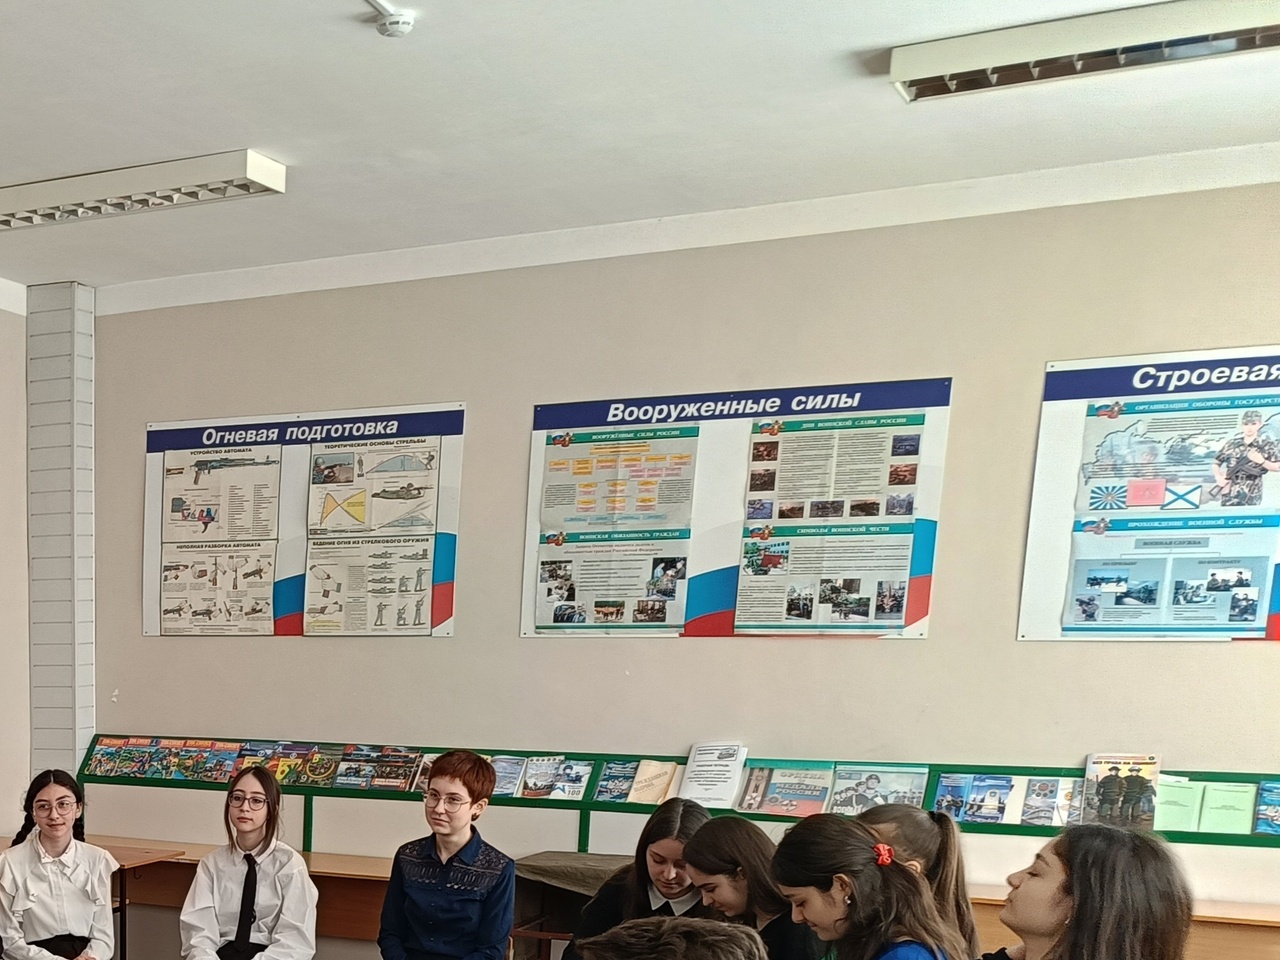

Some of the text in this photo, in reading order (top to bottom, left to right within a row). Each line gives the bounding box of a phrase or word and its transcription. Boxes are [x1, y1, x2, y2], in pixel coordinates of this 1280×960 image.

[1132, 364, 1280, 390] Строевая
[607, 391, 861, 424] Вооруженные силы
[201, 420, 399, 445] Огневая подготовка
[775, 788, 821, 797] РОССИИ
